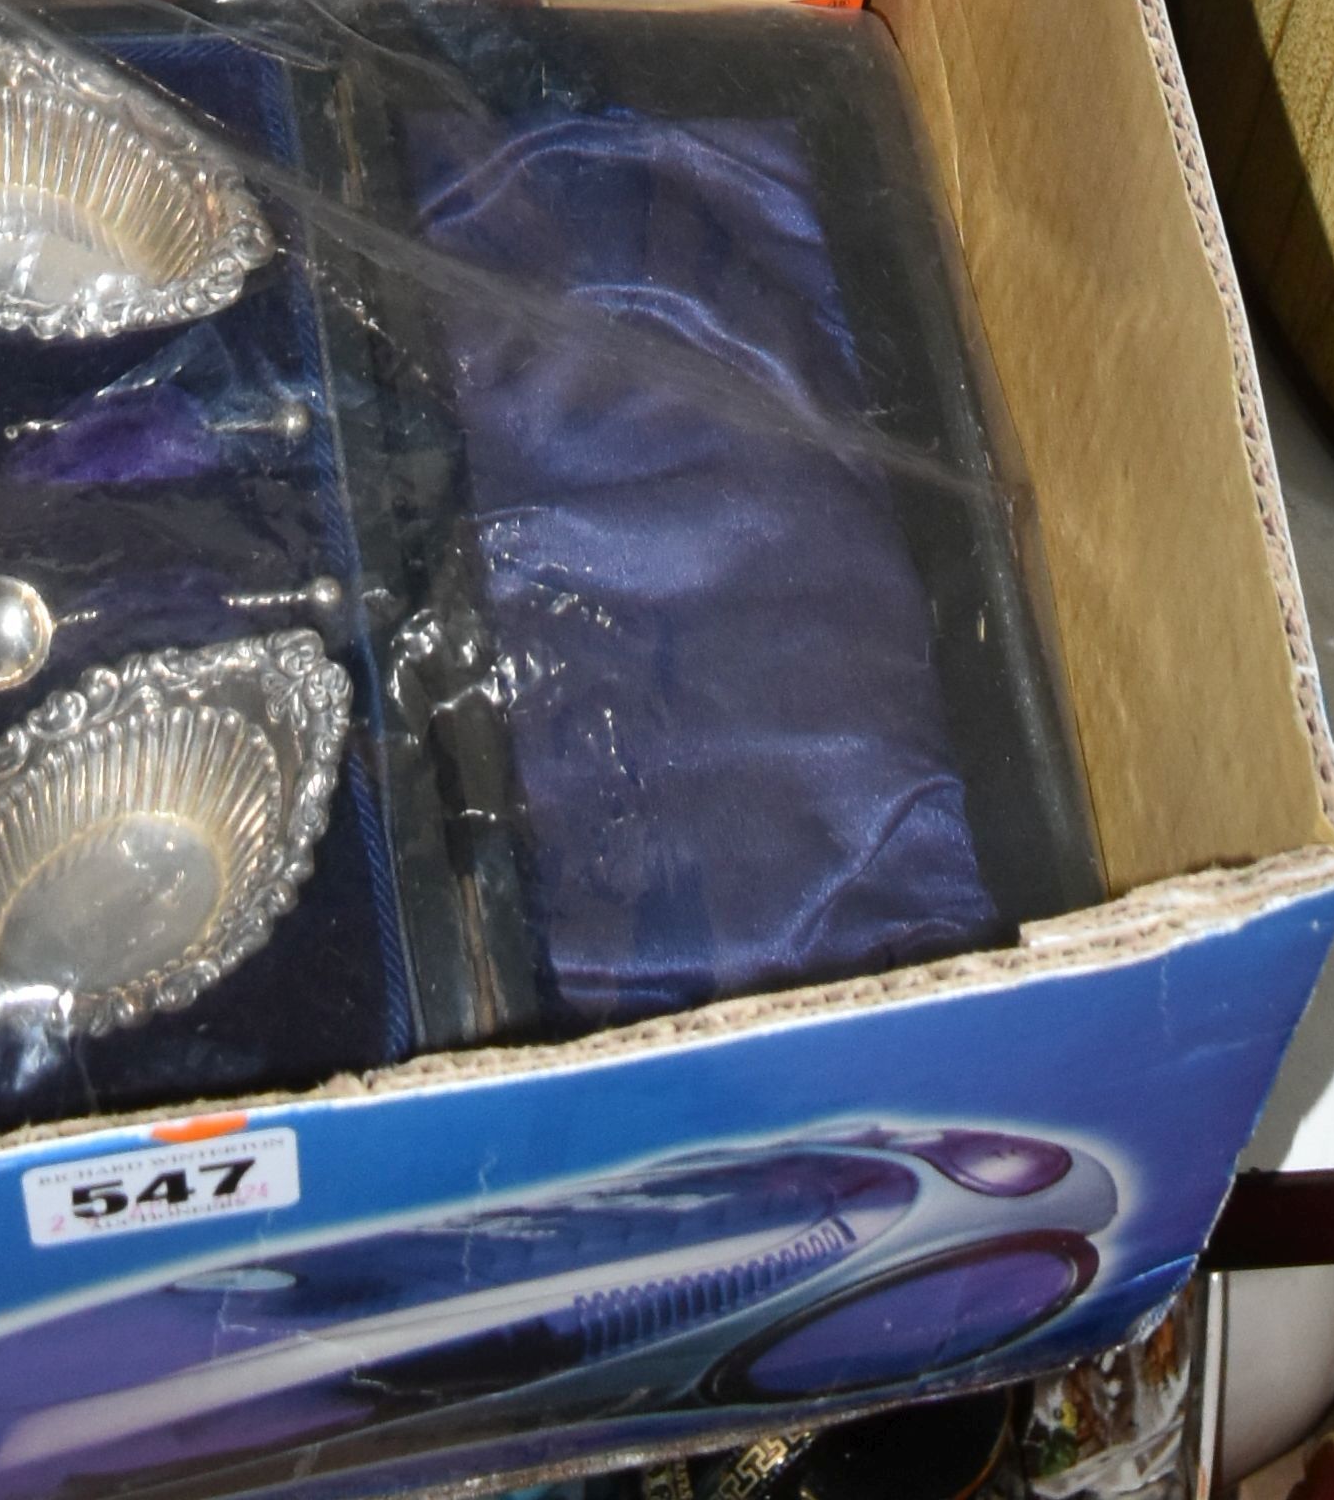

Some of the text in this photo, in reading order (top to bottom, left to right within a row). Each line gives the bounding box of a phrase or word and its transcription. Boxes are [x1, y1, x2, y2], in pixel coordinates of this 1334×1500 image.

[38, 1136, 285, 1187] RICHARD WINTERTON
[72, 1155, 256, 1219] 547
